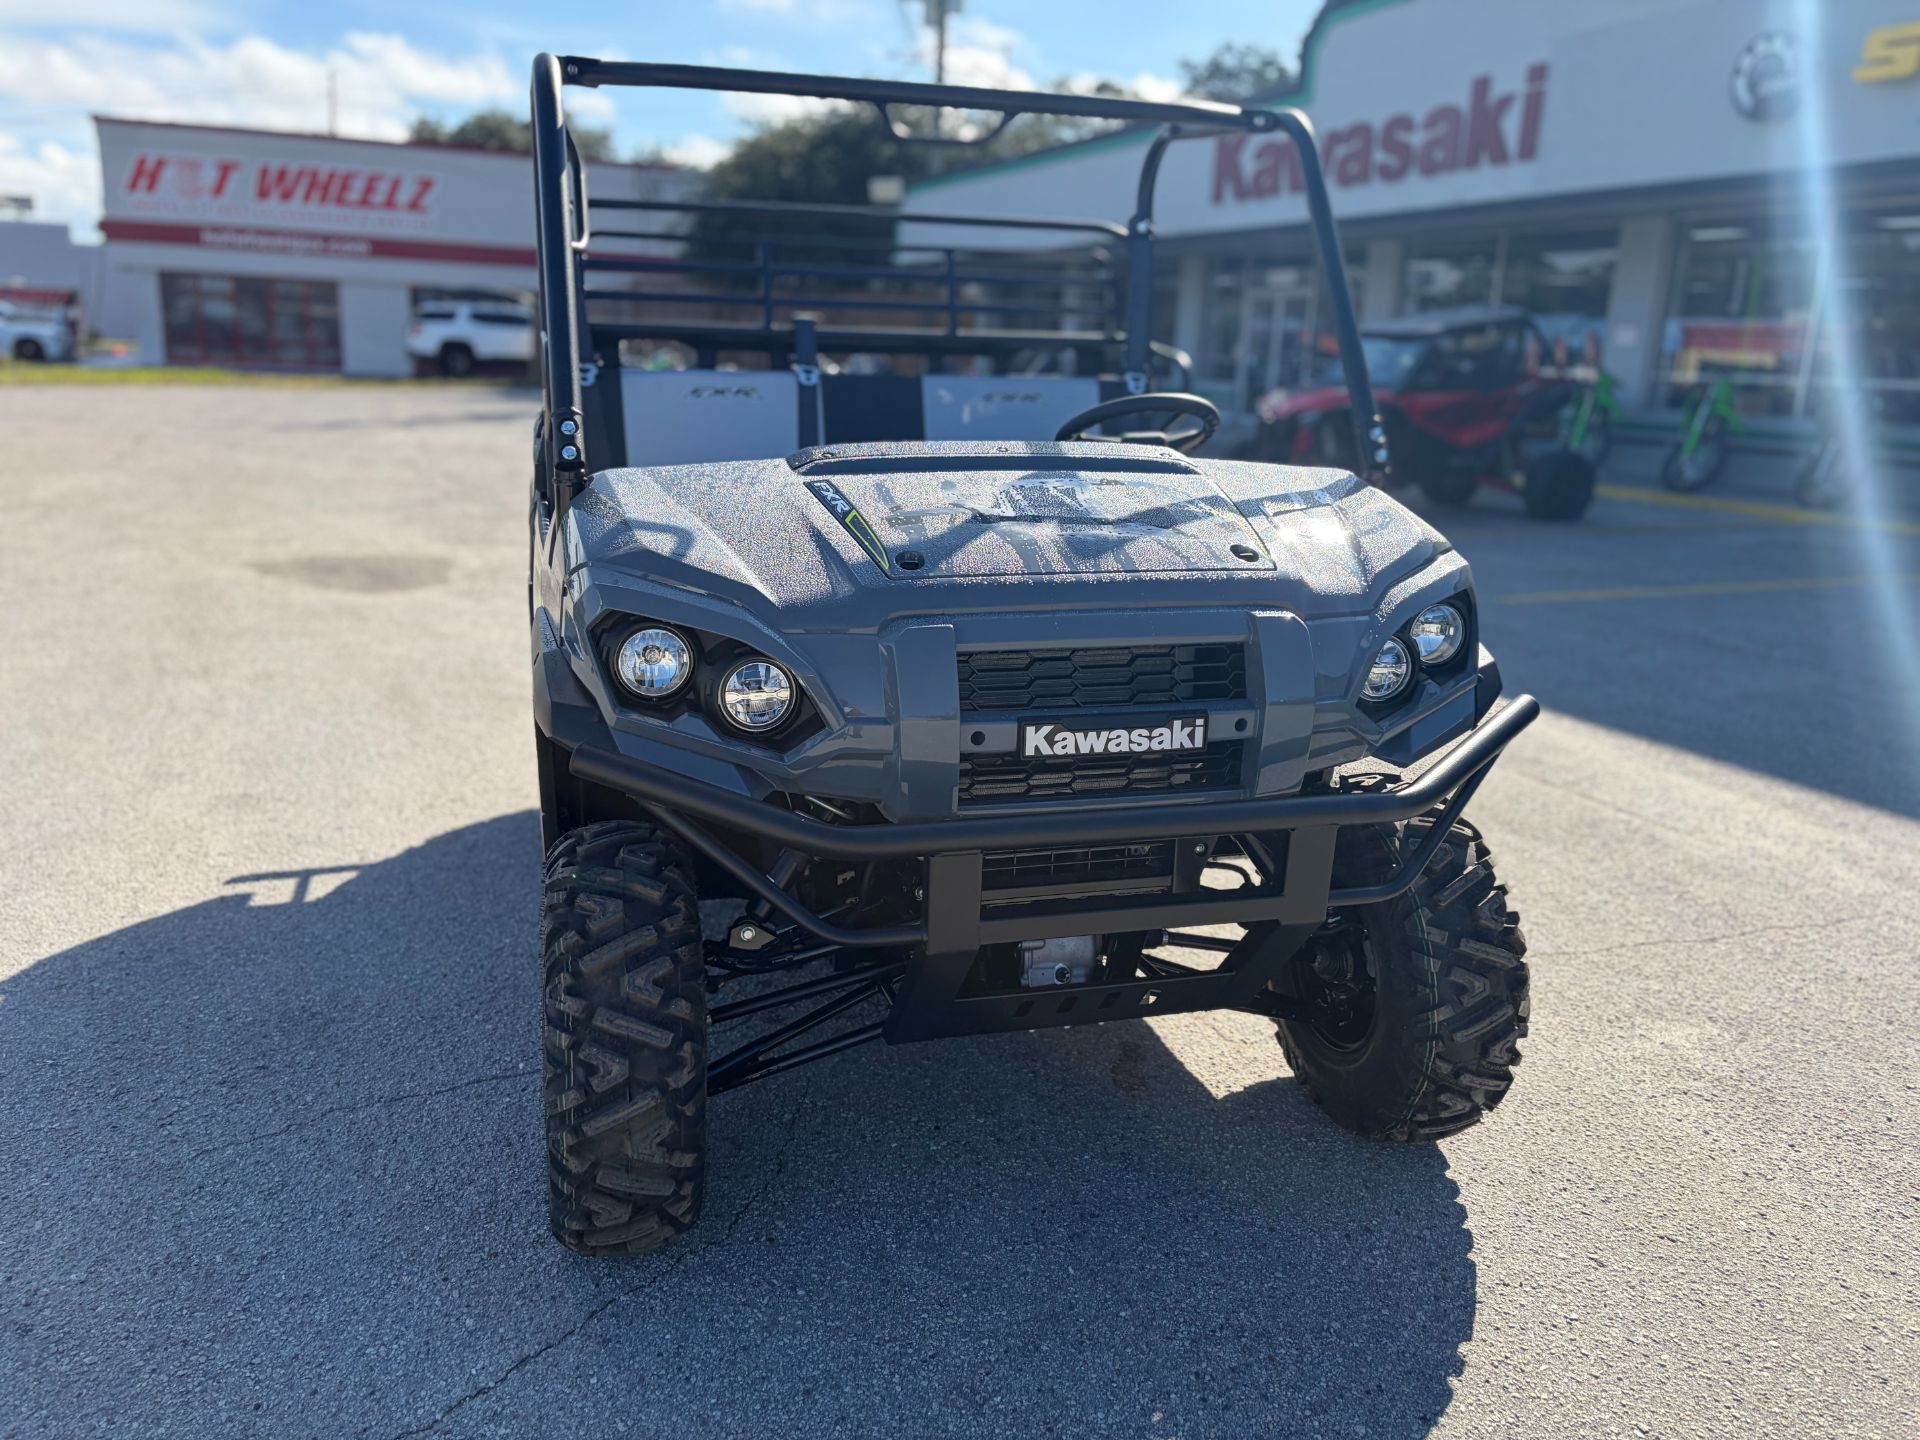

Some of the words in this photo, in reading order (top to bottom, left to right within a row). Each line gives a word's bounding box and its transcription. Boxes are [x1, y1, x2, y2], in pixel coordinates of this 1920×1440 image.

[127, 154, 241, 199] HT
[255, 162, 436, 213] WHEELZ
[812, 481, 851, 518] FXR
[1025, 718, 1205, 756] Kawasaki
